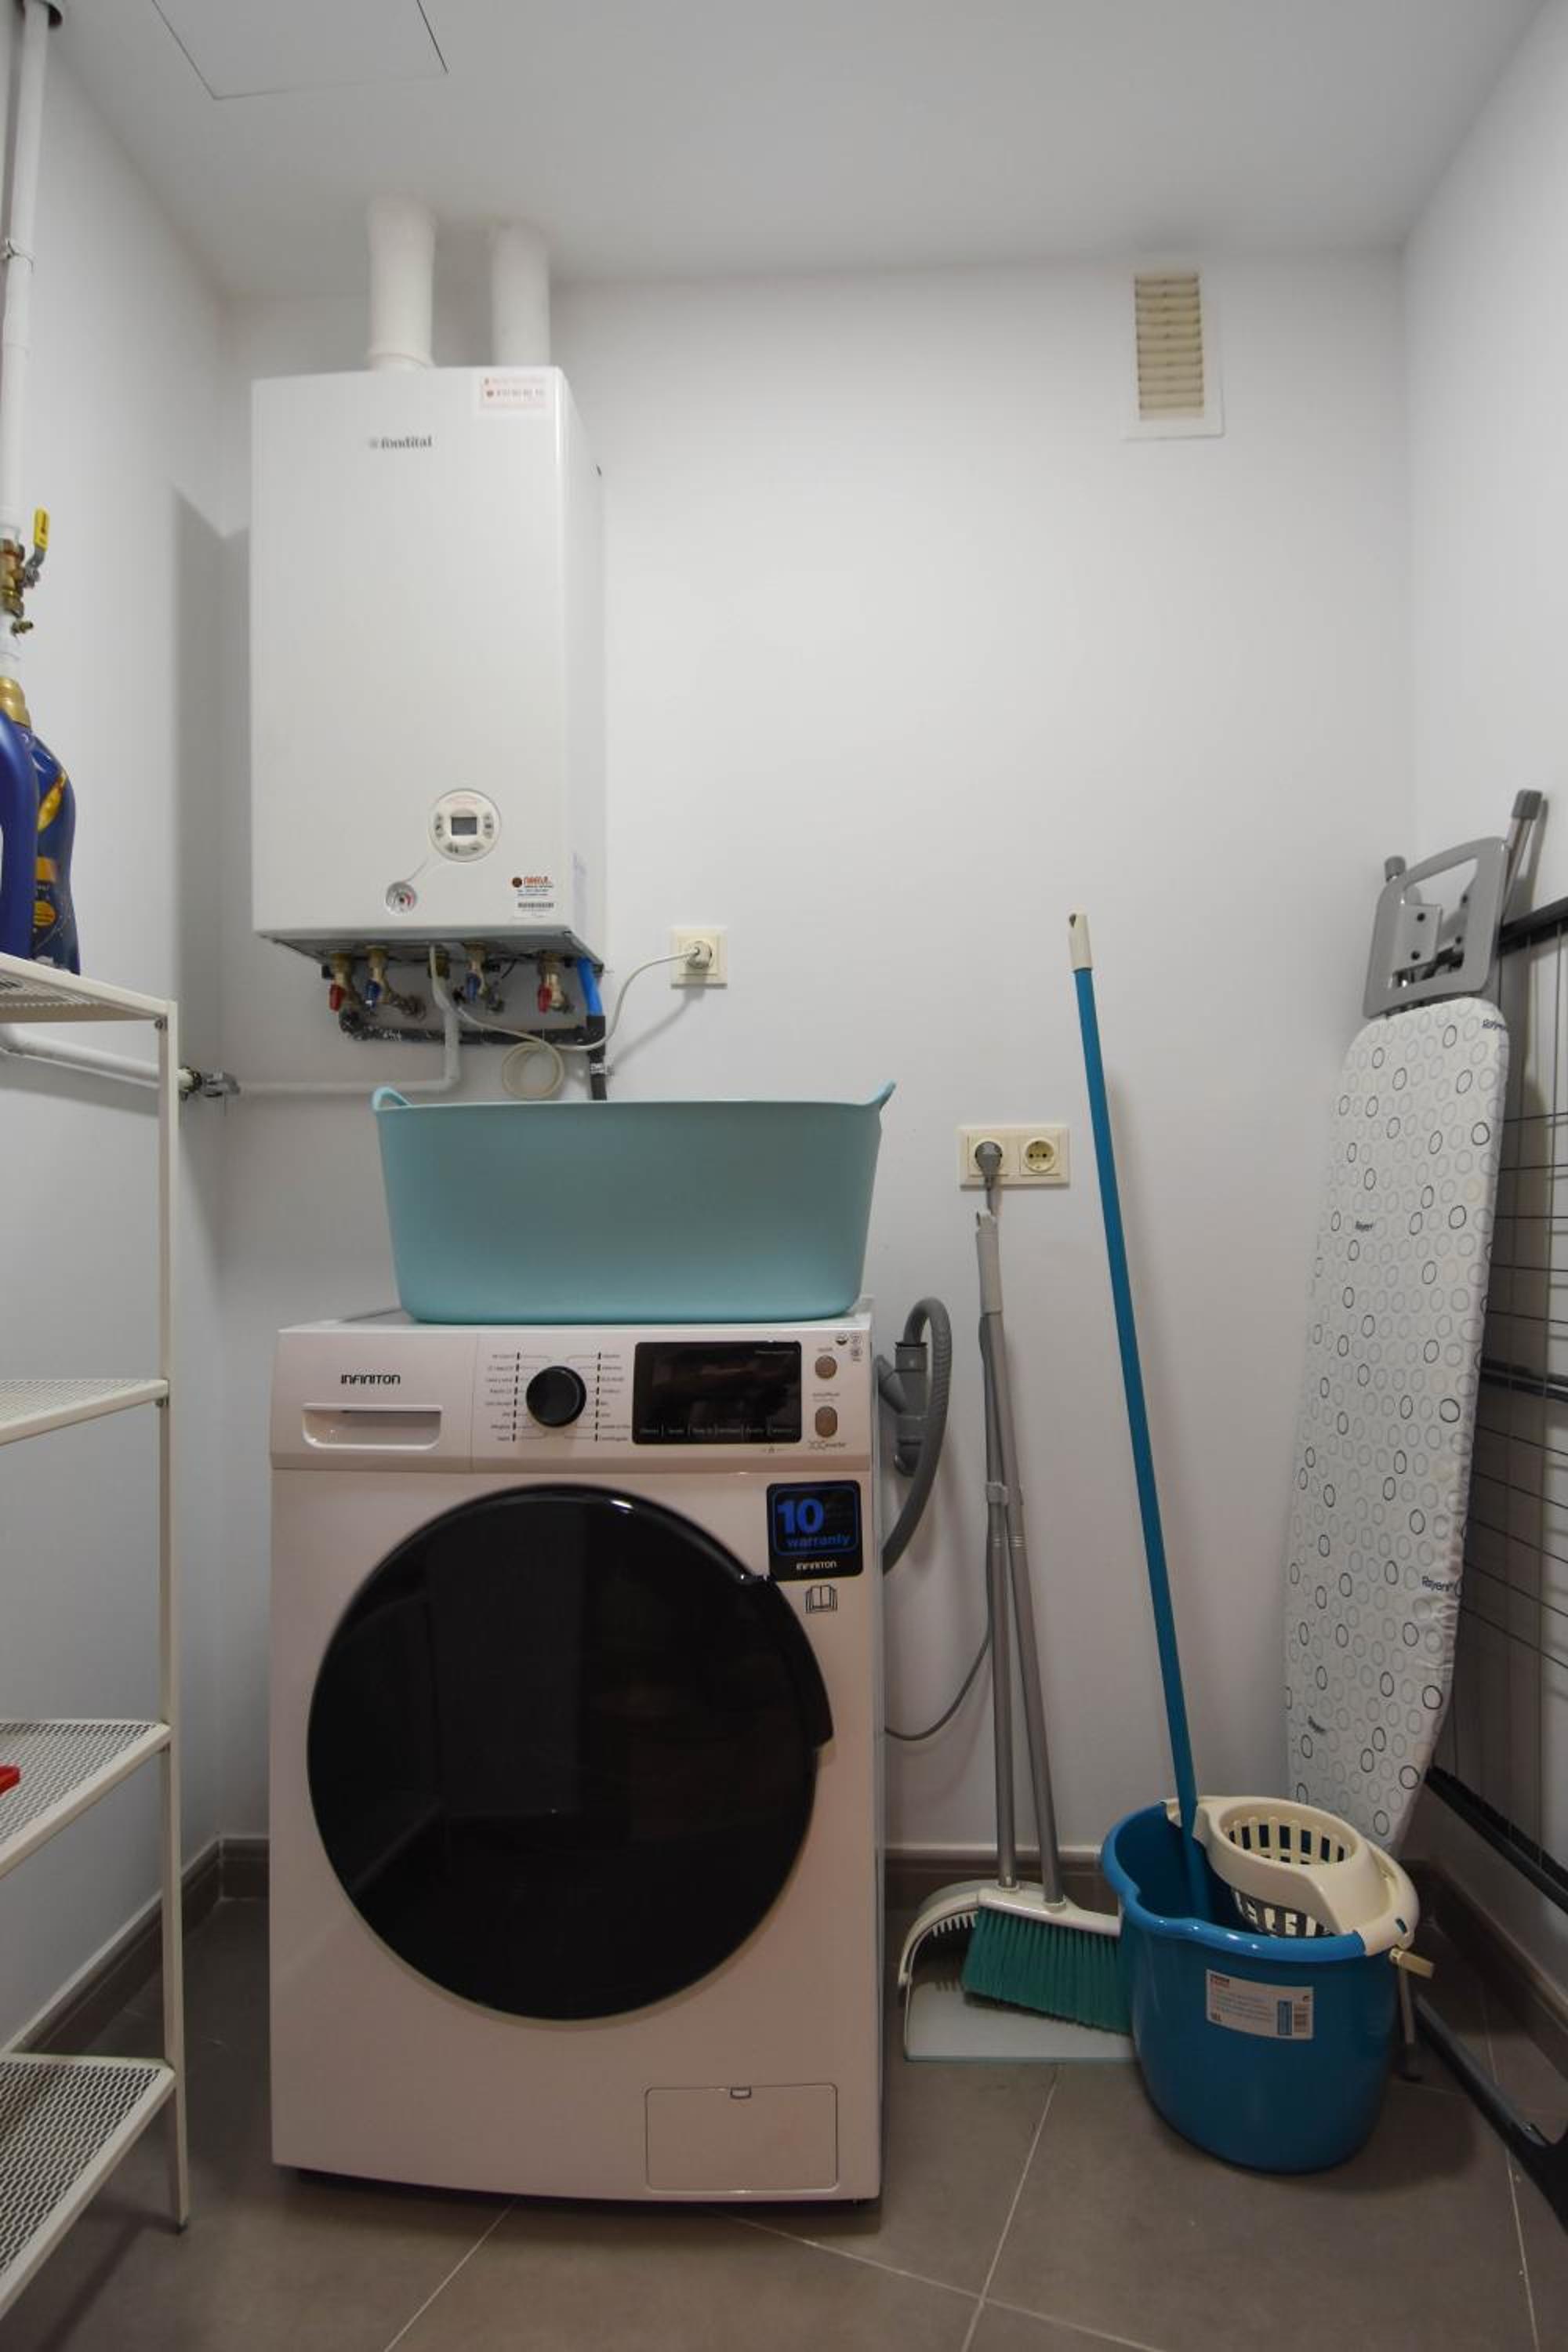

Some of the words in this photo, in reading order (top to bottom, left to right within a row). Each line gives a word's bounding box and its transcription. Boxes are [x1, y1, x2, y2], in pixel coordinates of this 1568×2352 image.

[381, 435, 432, 449] fondital
[340, 1374, 401, 1385] INFINITON
[778, 1497, 823, 1534] 10
[786, 1534, 851, 1548] warranty
